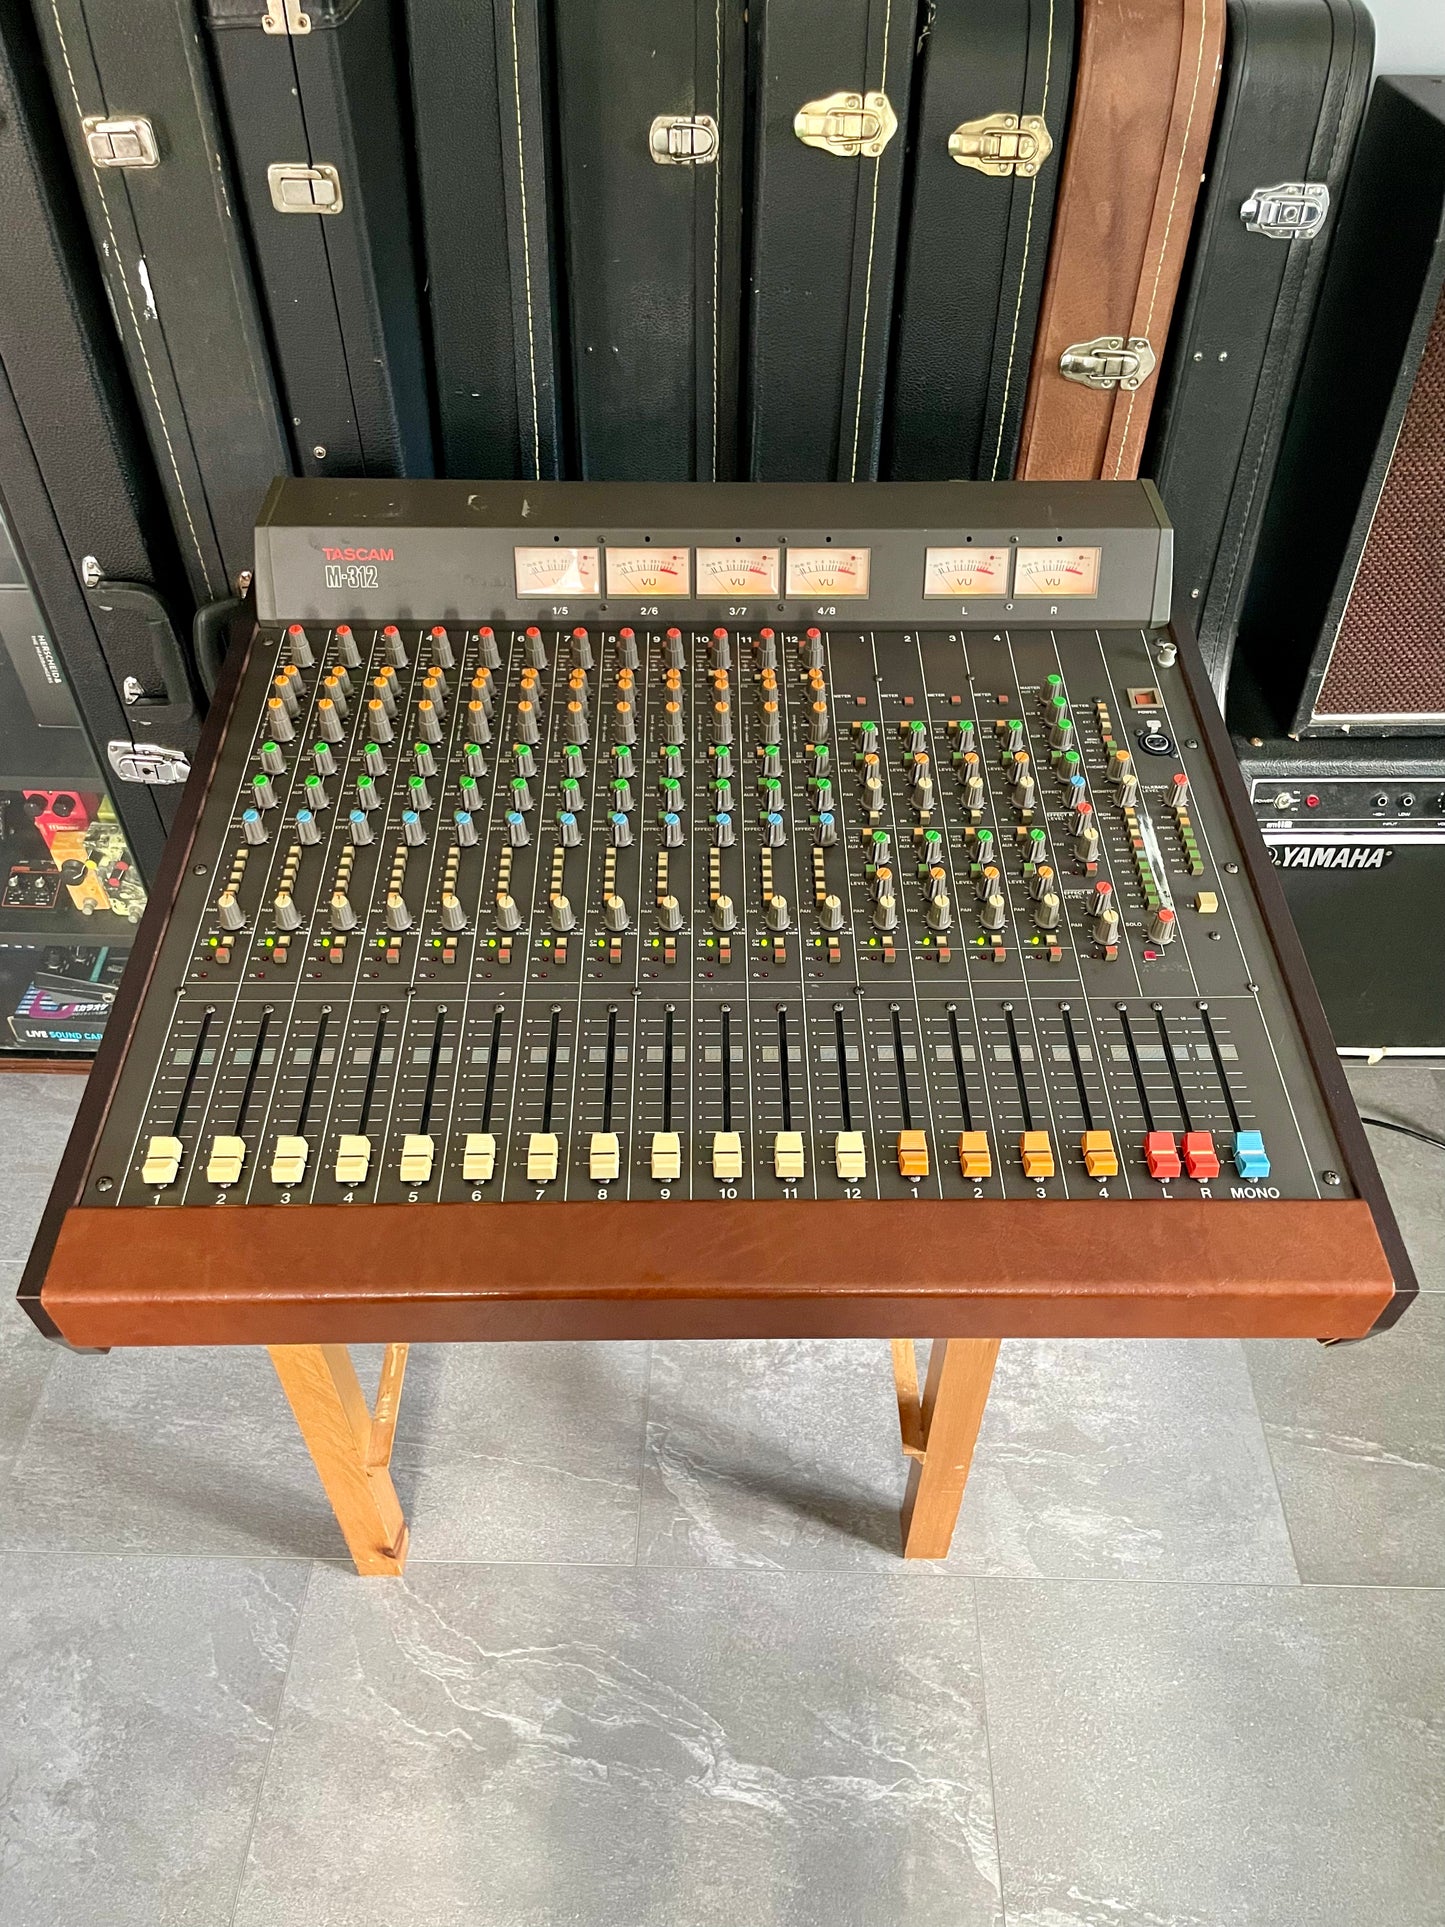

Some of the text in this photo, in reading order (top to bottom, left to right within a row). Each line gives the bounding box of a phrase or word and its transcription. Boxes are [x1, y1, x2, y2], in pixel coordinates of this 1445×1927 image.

[322, 547, 394, 561] TASCAM
[325, 565, 379, 589] M-312
[641, 607, 658, 615] 2/6
[730, 607, 746, 615] 3/7
[818, 607, 835, 615] 4/8
[1051, 606, 1057, 614] R
[1282, 847, 1384, 867] YAMAHA
[26, 1029, 48, 1039] LIVE
[48, 1031, 82, 1040] SOUND
[343, 1192, 354, 1204] 4
[408, 1192, 419, 1203] 5
[472, 1191, 482, 1202] 6
[536, 1190, 546, 1201] 7
[598, 1189, 608, 1201] 8
[661, 1189, 671, 1200] 9
[719, 1188, 738, 1200] 10
[783, 1188, 798, 1199] 11
[844, 1188, 862, 1199] 12
[911, 1188, 919, 1199] 1
[974, 1188, 984, 1199] 2
[1036, 1188, 1047, 1199] 3
[1099, 1188, 1110, 1199] 4
[1162, 1188, 1174, 1199] L
[1200, 1188, 1213, 1199] R
[1230, 1187, 1281, 1199] MONO
[154, 1195, 161, 1206] 1
[216, 1194, 227, 1205] 2
[280, 1193, 291, 1205] 3
